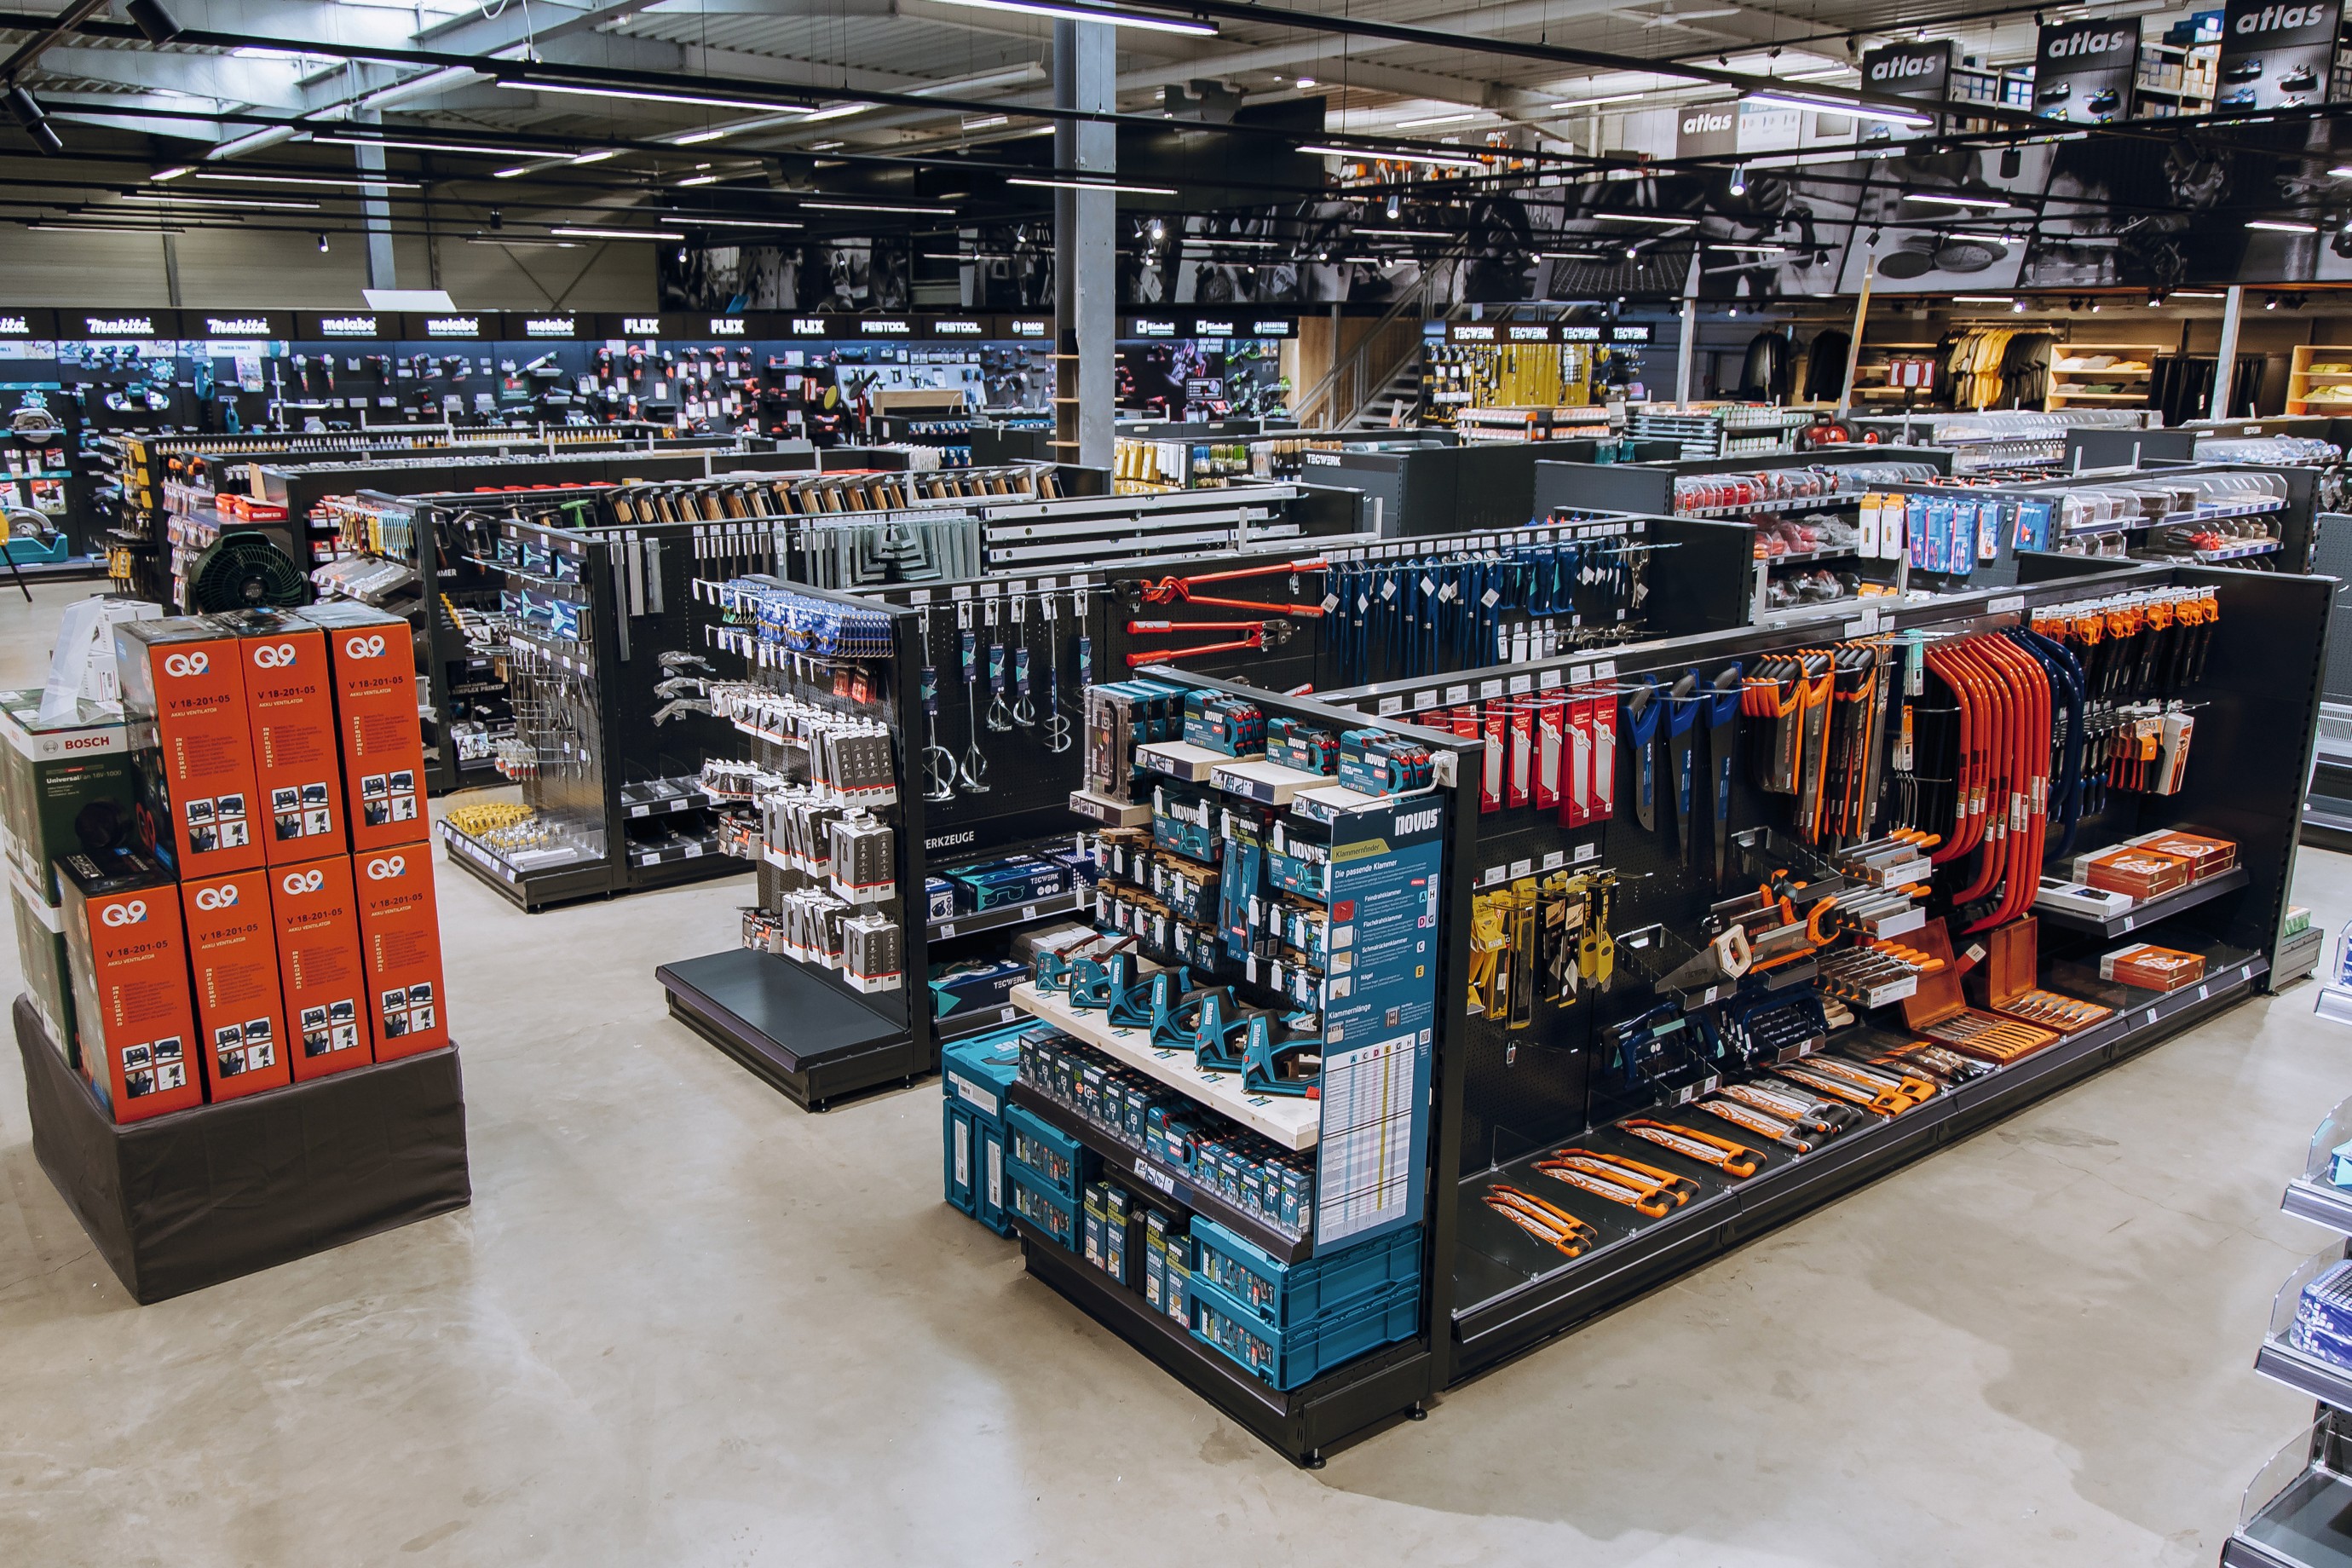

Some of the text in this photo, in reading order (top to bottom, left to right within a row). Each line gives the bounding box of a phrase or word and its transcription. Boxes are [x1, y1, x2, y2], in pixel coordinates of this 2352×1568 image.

[2236, 3, 2325, 35] atlas
[2049, 31, 2126, 58] atlas
[1871, 55, 1937, 80] atlas
[1683, 113, 1732, 135] atlas
[0, 316, 30, 334] ita
[322, 318, 377, 331] metabo
[427, 318, 479, 331] metabo
[527, 318, 574, 331] metabo
[624, 319, 660, 334] FLEX
[711, 320, 745, 334] FLEX
[793, 320, 825, 334] FLEX
[862, 321, 910, 333] FESTOOL
[936, 321, 982, 333] FESTOOL
[1454, 326, 1495, 339] TECWERK
[1509, 327, 1548, 339] TECWERK
[1563, 327, 1600, 339] TECWERK
[1613, 327, 1648, 339] TECWERK
[1306, 453, 1341, 467] TECWERK
[345, 635, 385, 660] Q9
[254, 643, 297, 668] Q9
[164, 651, 210, 677] Q9
[359, 676, 404, 688] 18-201-05
[268, 686, 316, 698] 18-201-05
[364, 688, 392, 696] VENTILATOR
[181, 695, 231, 707] 18-201-05
[274, 698, 303, 706] VENTILATOR
[187, 707, 217, 717] VENTILATOR
[65, 736, 110, 750] BOSCH
[925, 830, 975, 850] ERKZEUGE
[1335, 844, 1381, 858] Klammernfinder
[366, 855, 406, 881] Q9
[1335, 860, 1398, 879] Die passende Klammer
[283, 869, 324, 896] Q9
[1030, 873, 1059, 885] TECWERK
[195, 884, 239, 911] Q9
[380, 893, 423, 907] 18-201-05
[1421, 890, 1435, 902] A H
[101, 900, 147, 927] Q9
[297, 908, 343, 923] 18-201-05
[383, 905, 412, 914] VENTILATOR
[303, 920, 331, 931] VENTILATOR
[1419, 914, 1433, 926] D G
[210, 924, 258, 938] 18-201-05
[118, 940, 169, 956] 18-201-05
[216, 937, 246, 947] VENTILATOR
[1418, 942, 1423, 950] C
[123, 953, 155, 964] VENTILATOR
[1417, 967, 1422, 976] E
[993, 974, 1026, 990] TECWERK
[1328, 1003, 1371, 1020] Klammernlänge
[1351, 1055, 1357, 1064] A
